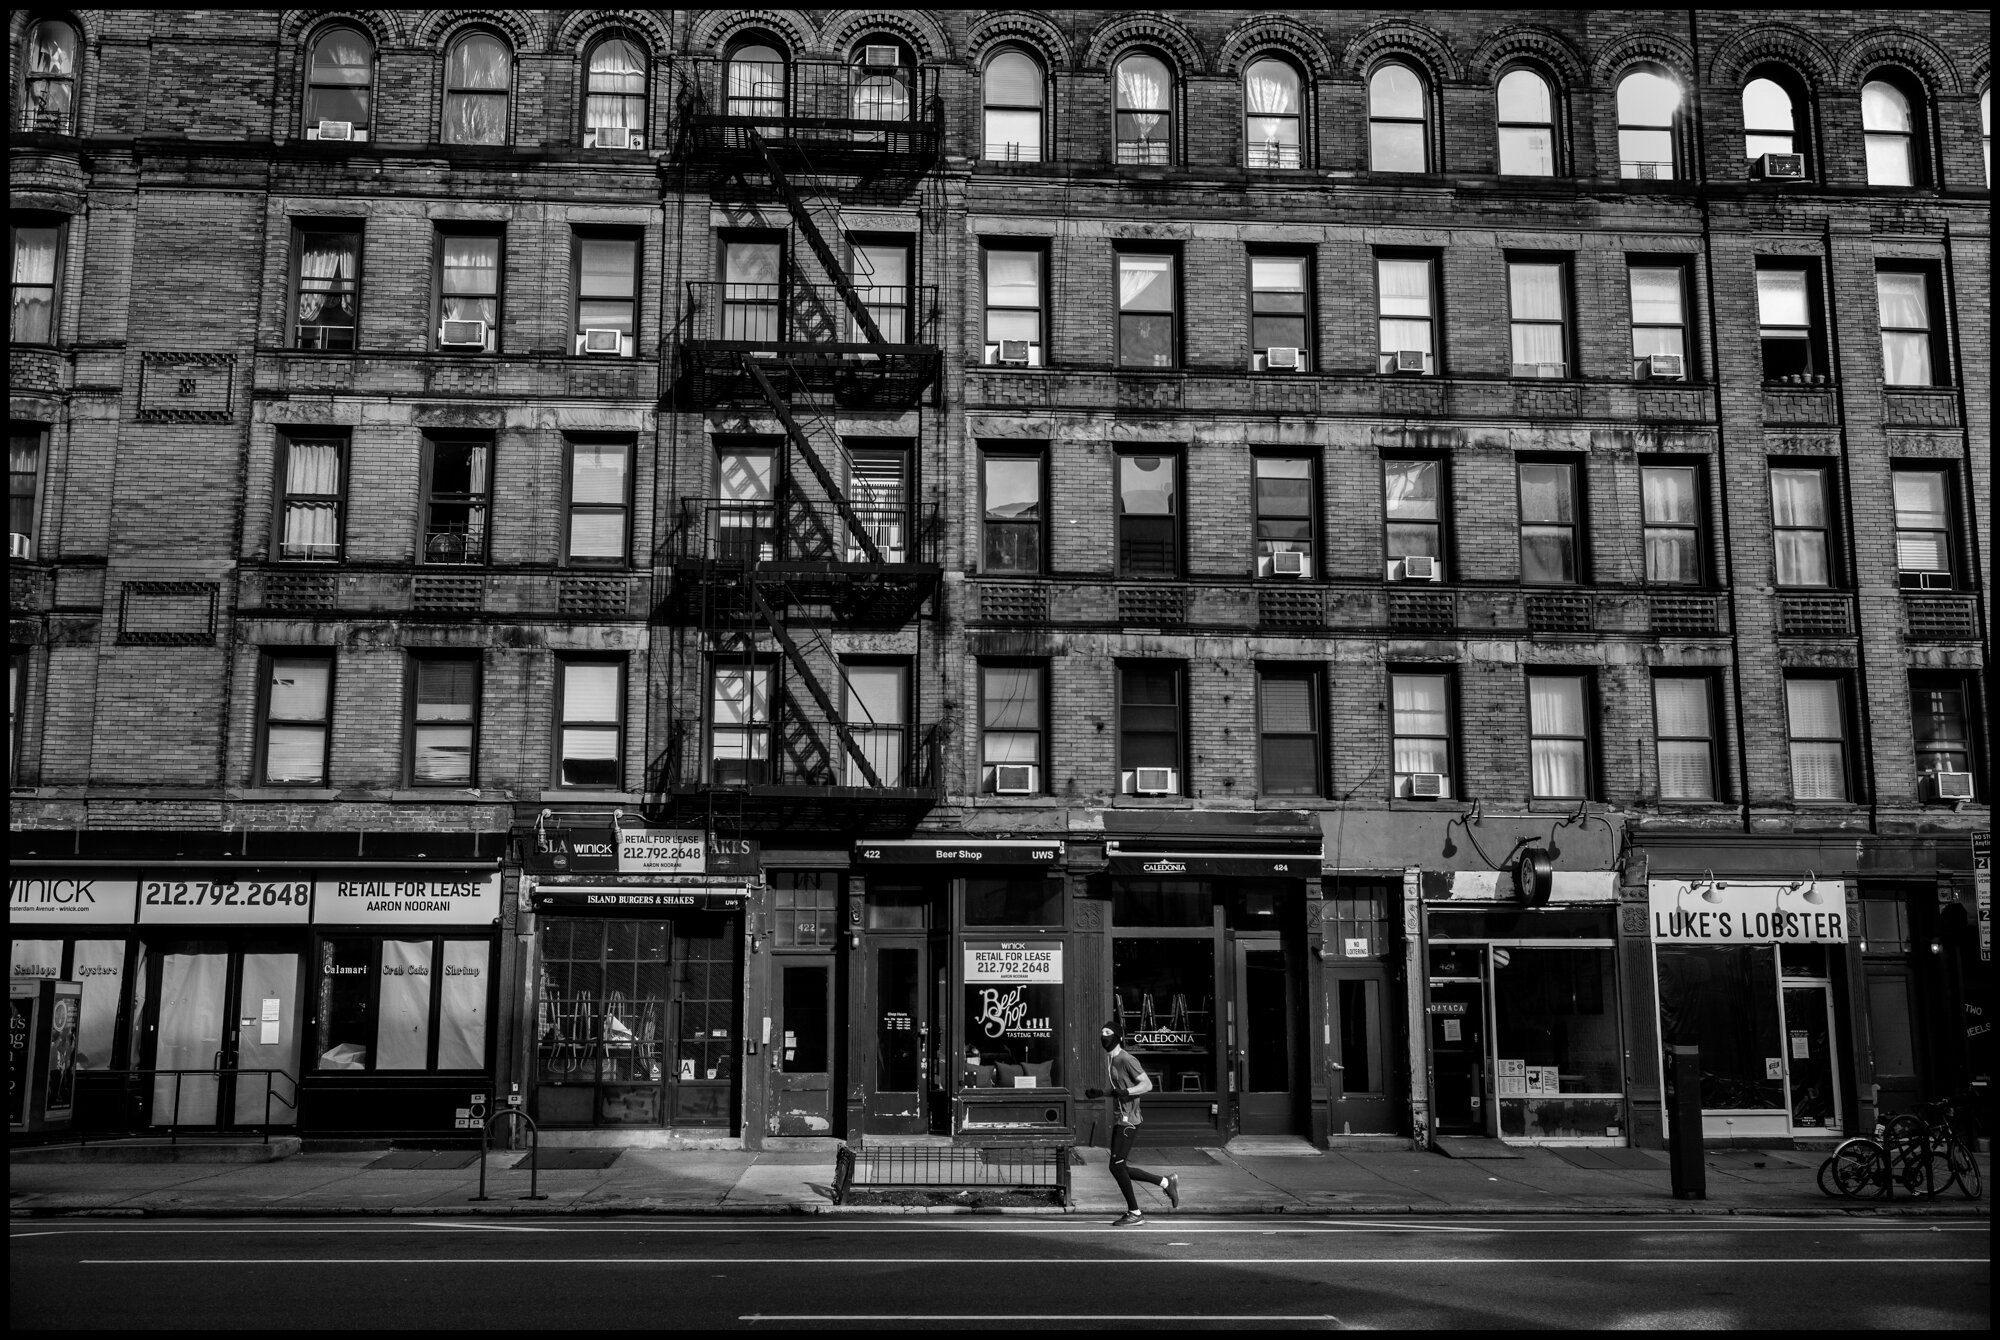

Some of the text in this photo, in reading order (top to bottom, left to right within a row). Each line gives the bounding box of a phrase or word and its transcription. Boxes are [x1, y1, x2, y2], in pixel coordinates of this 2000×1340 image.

[625, 835, 699, 844] RETAIL FOR LEASE
[623, 847, 701, 859] 212.792.2648
[864, 850, 881, 859] 422
[936, 850, 982, 860] Beer Shop
[1032, 850, 1054, 859] UWS
[1273, 864, 1288, 872] 424
[146, 882, 309, 906] 212.792.2648
[337, 881, 481, 897] RETAIL FOR LEASE
[587, 895, 695, 905] ISLAND BURGERS & SHAKES
[366, 901, 450, 911] AARON NOORANI
[798, 923, 816, 932] 422
[1655, 911, 1842, 939] LUKE'S LOBSTER
[975, 952, 1051, 961] RETAIL FOR LEASE
[13, 965, 57, 976] Scallops
[78, 965, 118, 976] Oysters
[324, 964, 368, 975] Calamari
[382, 965, 429, 976] Crab Cake
[445, 965, 480, 978] Shrimp
[977, 962, 1050, 973] 212.792.2648
[1439, 962, 1456, 970] 424
[974, 984, 1027, 1024] Beer
[1964, 1003, 1983, 1016] TWO
[984, 1002, 1028, 1038] Shop
[1134, 1033, 1195, 1043] CALEDONIA
[681, 1062, 691, 1074] A
